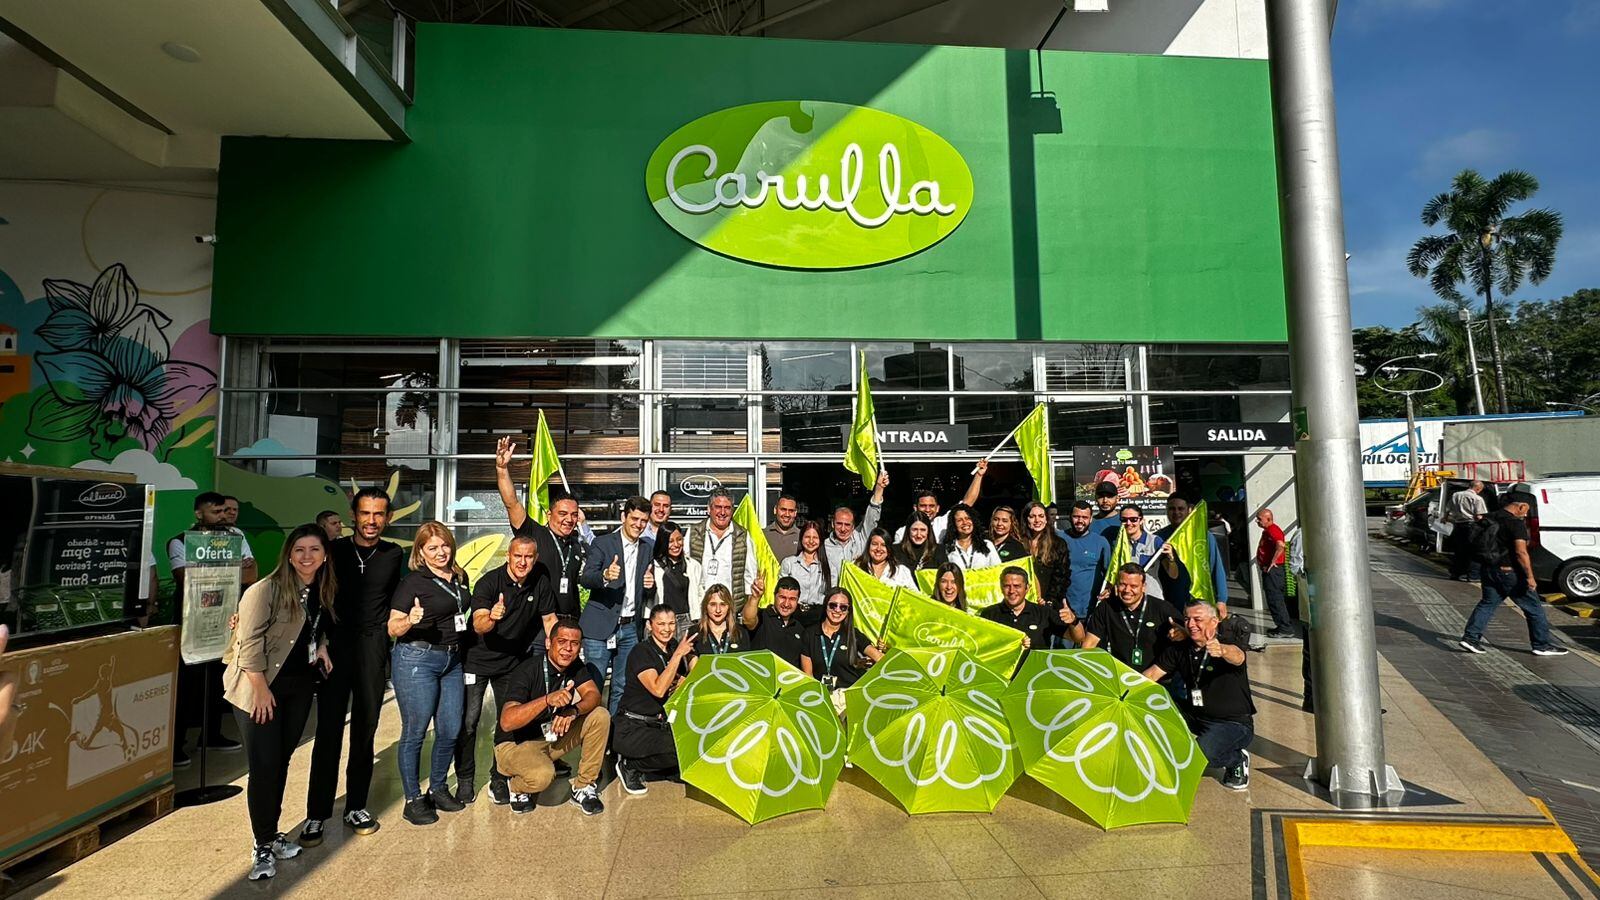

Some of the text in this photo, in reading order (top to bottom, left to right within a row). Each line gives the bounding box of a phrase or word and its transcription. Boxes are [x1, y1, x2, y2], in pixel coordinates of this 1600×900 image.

[666, 142, 956, 228] Carulla
[874, 431, 948, 443] NTRADA
[1207, 429, 1266, 442] SALIDA
[1361, 452, 1440, 465] RILOGSTI
[686, 507, 708, 515] Abier
[195, 546, 233, 560] Oferta
[20, 728, 47, 754] 4K
